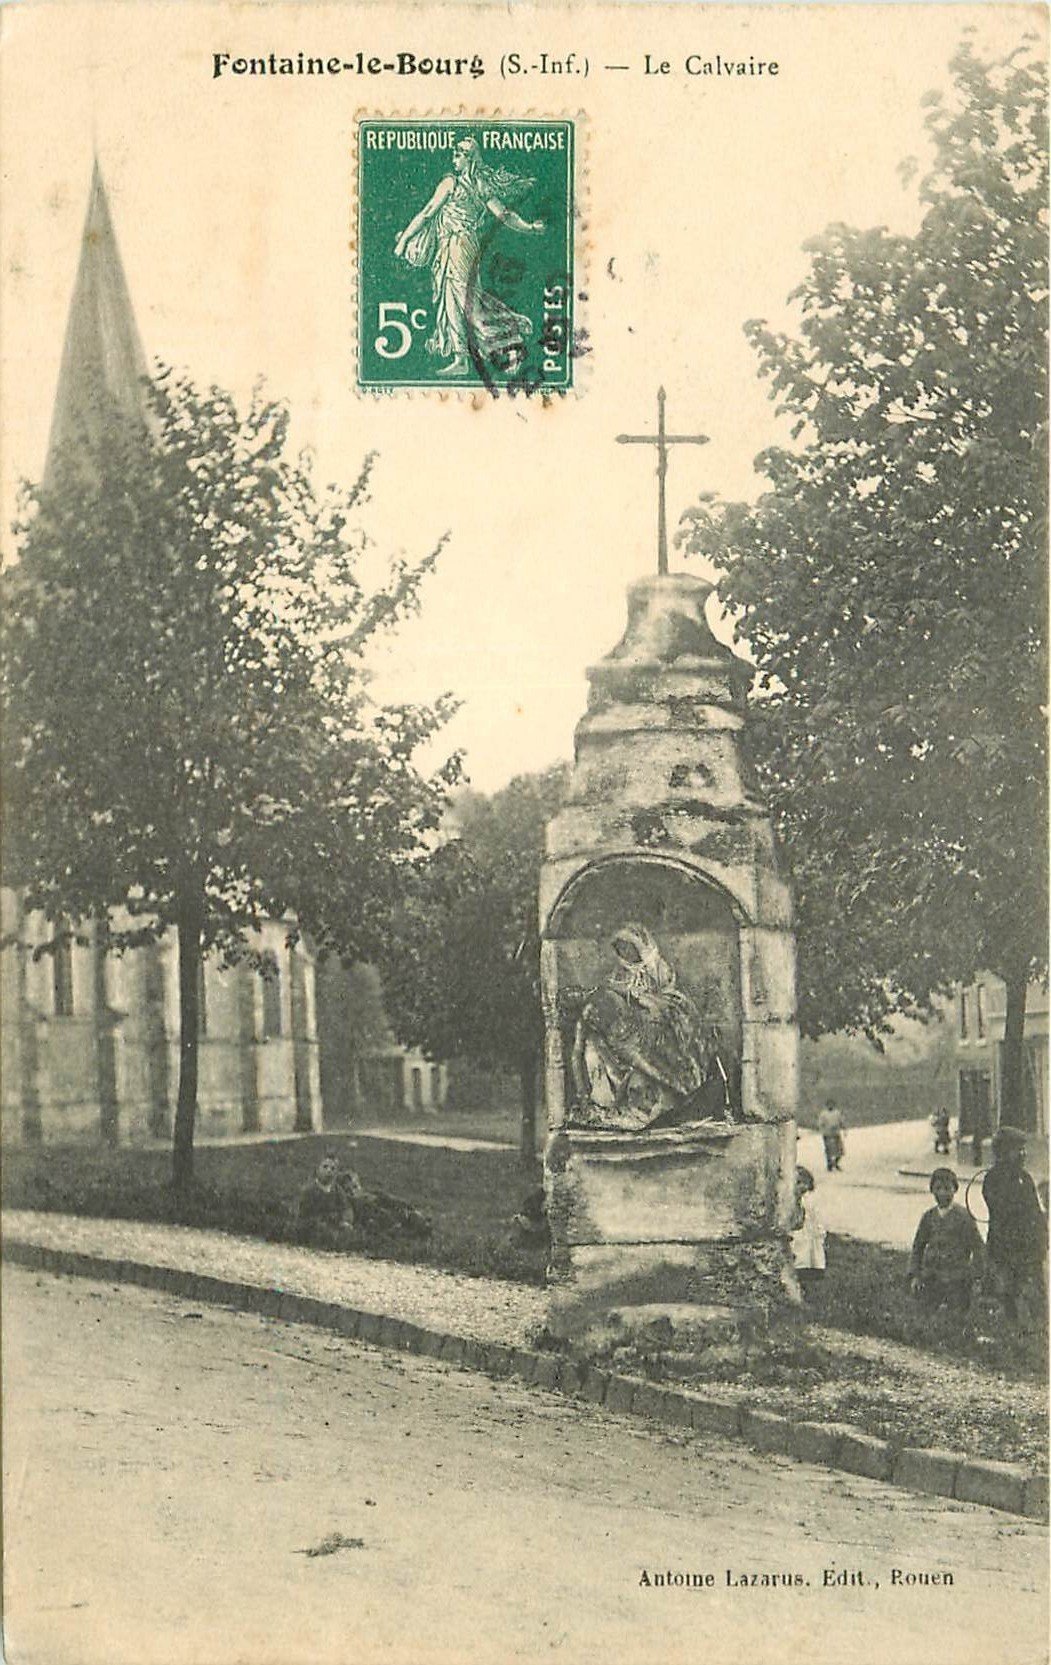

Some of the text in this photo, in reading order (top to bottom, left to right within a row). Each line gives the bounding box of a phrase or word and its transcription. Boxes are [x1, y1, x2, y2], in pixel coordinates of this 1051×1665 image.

[366, 130, 565, 153] REPUBLIQUE FRANÇAISE
[543, 285, 564, 373] POSTES
